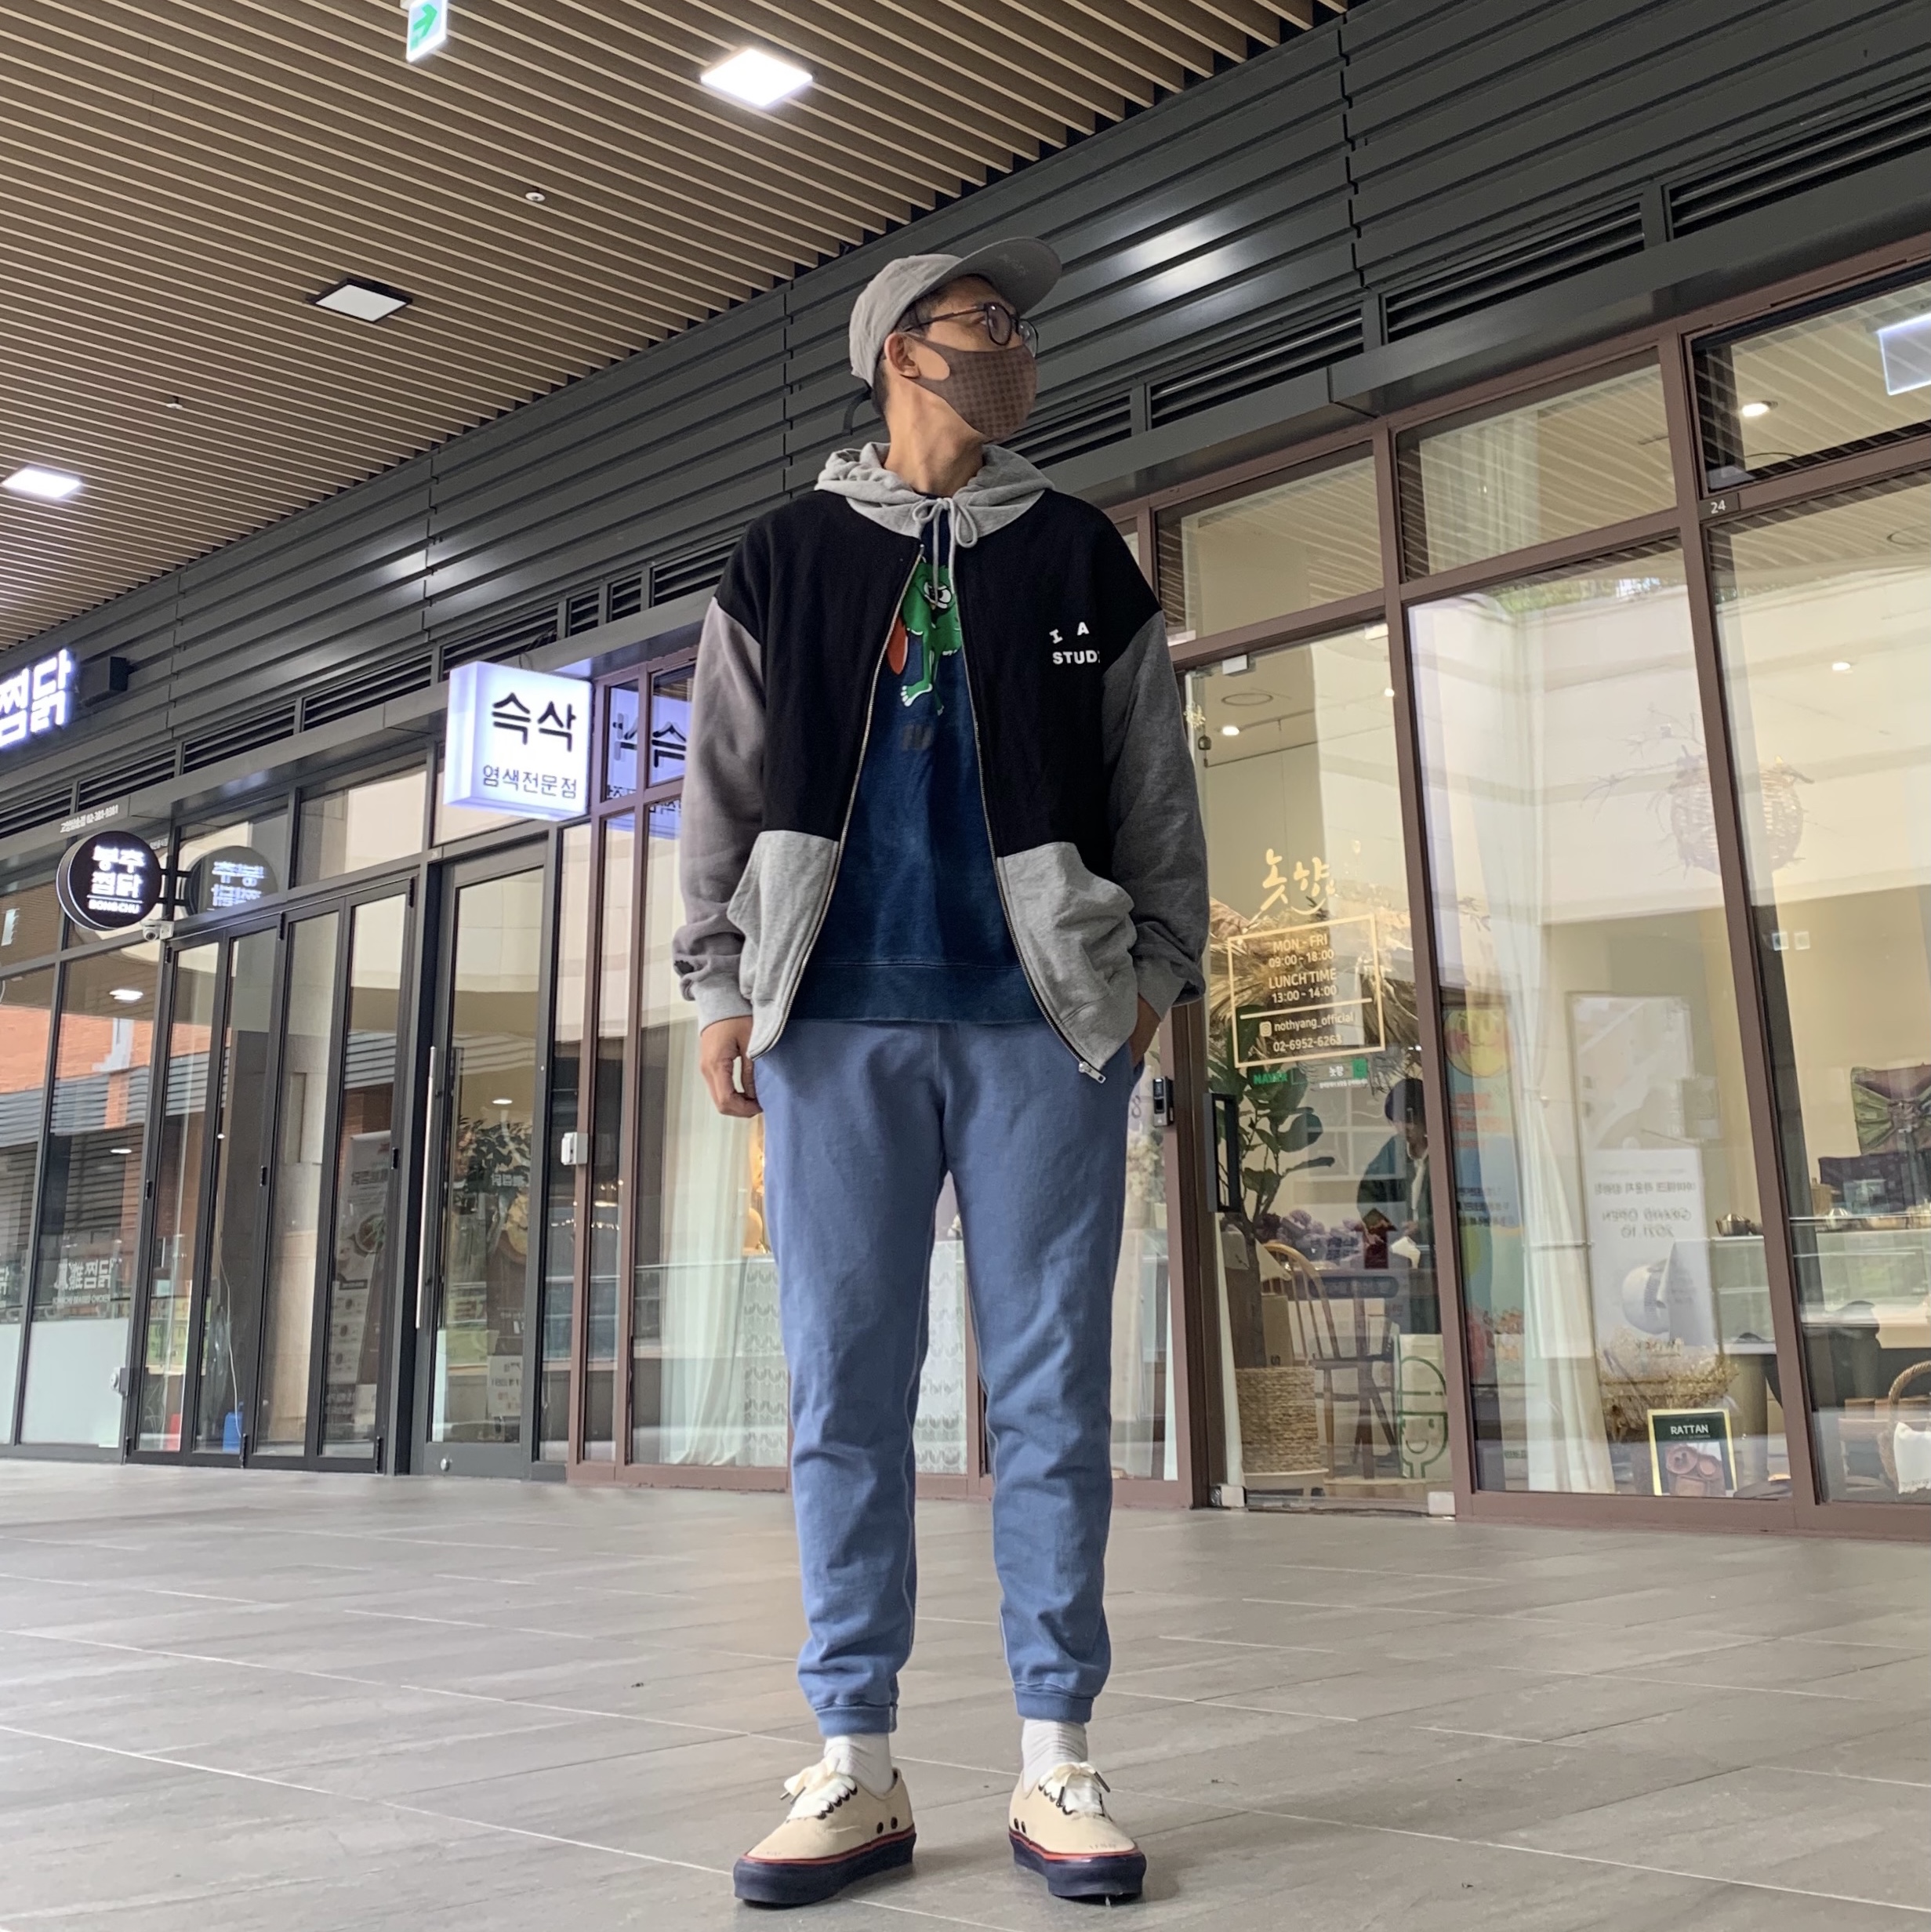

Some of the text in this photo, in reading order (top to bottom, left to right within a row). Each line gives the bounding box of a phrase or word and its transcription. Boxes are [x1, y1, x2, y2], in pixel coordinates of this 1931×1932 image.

[1711, 499, 1726, 514] 24
[1049, 622, 1090, 644] I A
[1052, 649, 1101, 665] STUD
[491, 692, 577, 753] 슥삭
[482, 764, 578, 800] 염색전문점
[93, 844, 146, 873] 봉추
[91, 871, 144, 899] 찜닭
[1272, 938, 1301, 953] MON
[1309, 933, 1329, 949] FRI
[1268, 953, 1298, 969] 09:00
[1306, 949, 1335, 962] 18:00
[1268, 968, 1338, 990] LUNCH TIME
[1272, 990, 1301, 1004] 13:00
[1309, 984, 1338, 999] 14:00
[1272, 1033, 1343, 1053] 02-6952-6263
[1670, 1424, 1709, 1435] RATTAN
